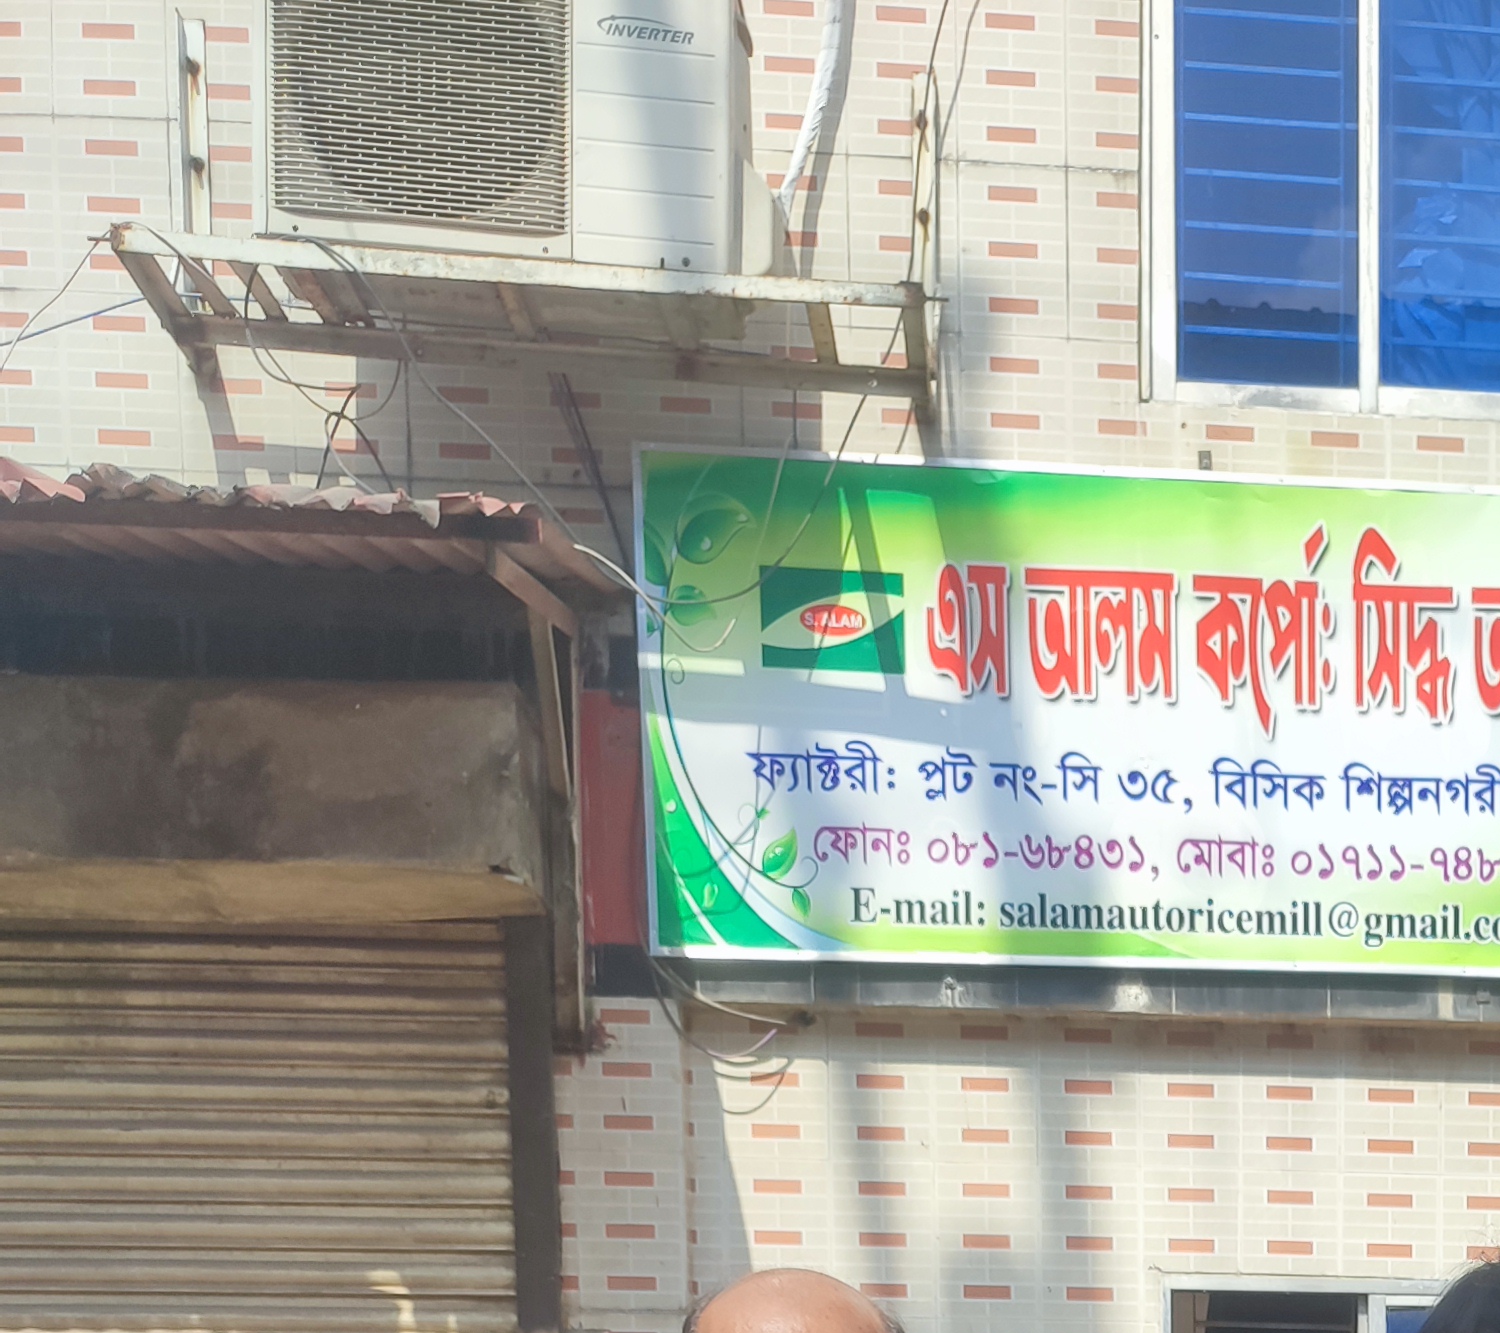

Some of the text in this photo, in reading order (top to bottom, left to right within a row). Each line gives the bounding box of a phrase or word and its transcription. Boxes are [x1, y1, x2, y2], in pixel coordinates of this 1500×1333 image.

[606, 23, 695, 44] INVERTER
[926, 563, 1006, 694] এস
[1025, 568, 1174, 698] আলম
[1353, 527, 1453, 719] সিদ্ধ
[918, 746, 977, 801] প্লট
[990, 752, 1103, 804] নং-সি
[1118, 769, 1193, 813] ৩৫,
[1208, 757, 1327, 811] বিসিক
[928, 831, 1159, 882] ০৮১-৬৮৪৩১,
[850, 887, 985, 927] E-mail:
